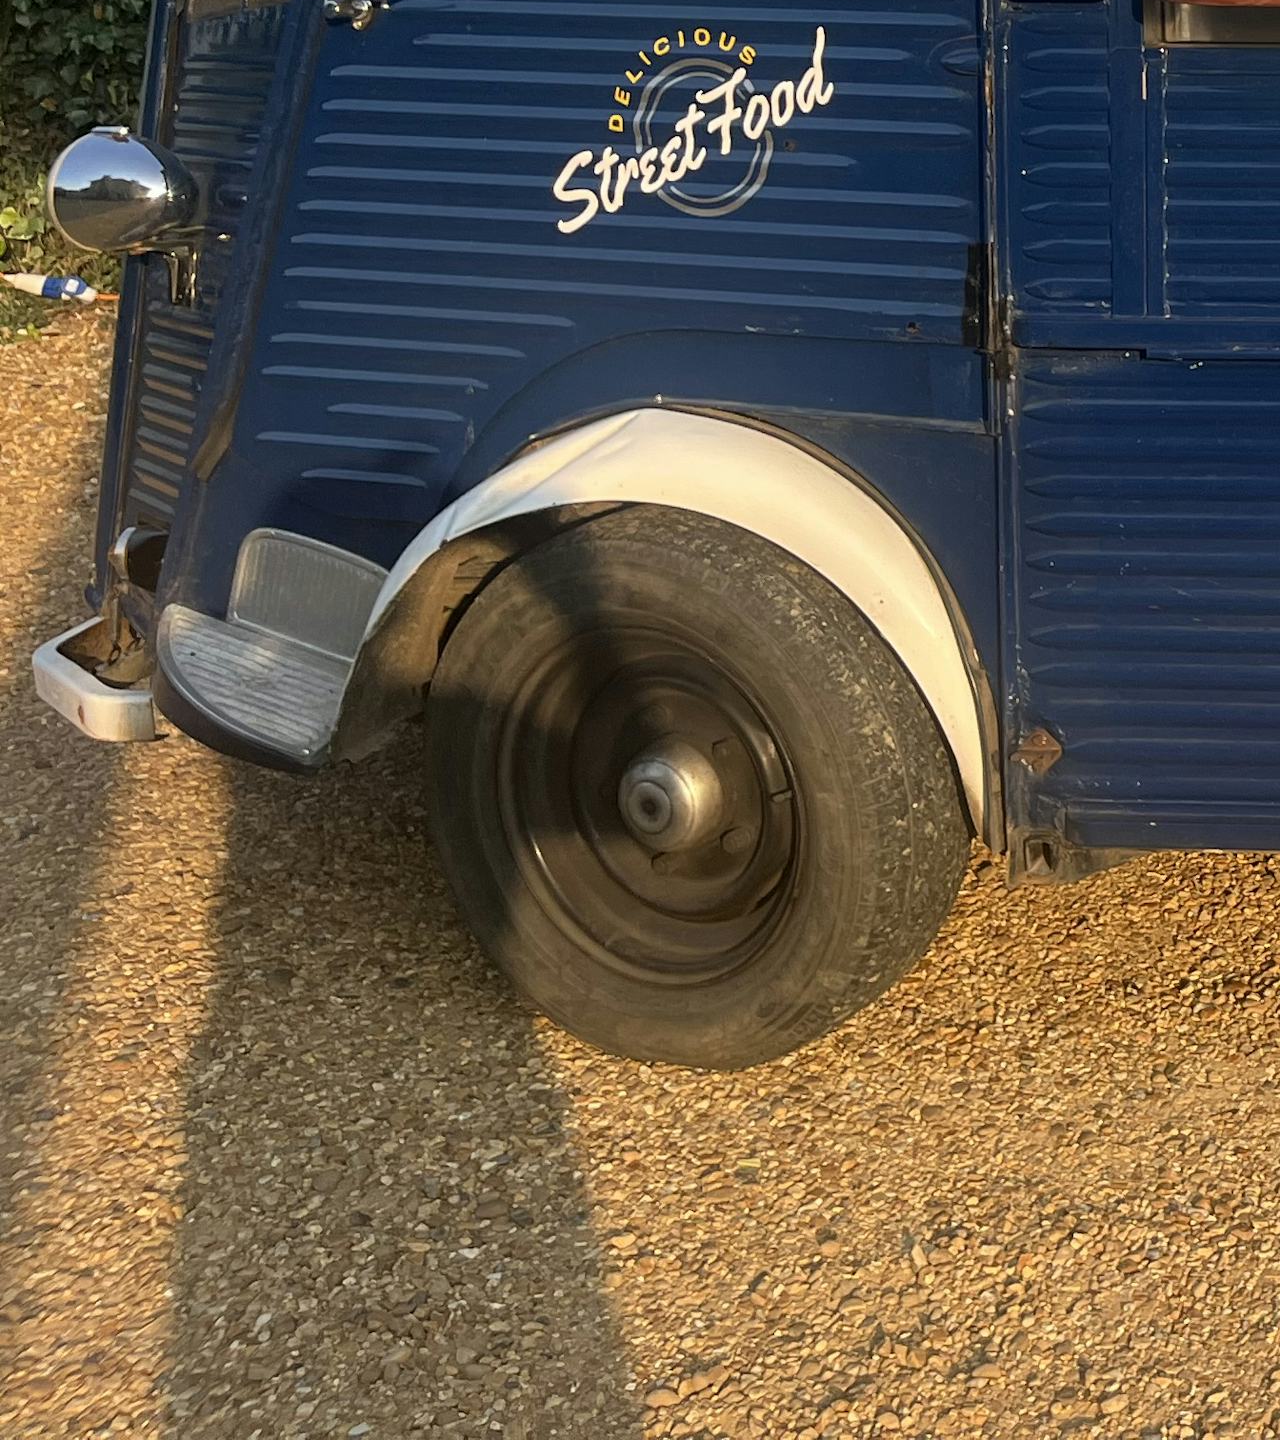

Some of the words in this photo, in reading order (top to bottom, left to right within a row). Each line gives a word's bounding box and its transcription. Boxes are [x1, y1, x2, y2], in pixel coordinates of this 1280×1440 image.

[553, 103, 707, 234] Street
[695, 25, 835, 156] Food
[608, 27, 757, 132] DELICIOUS
